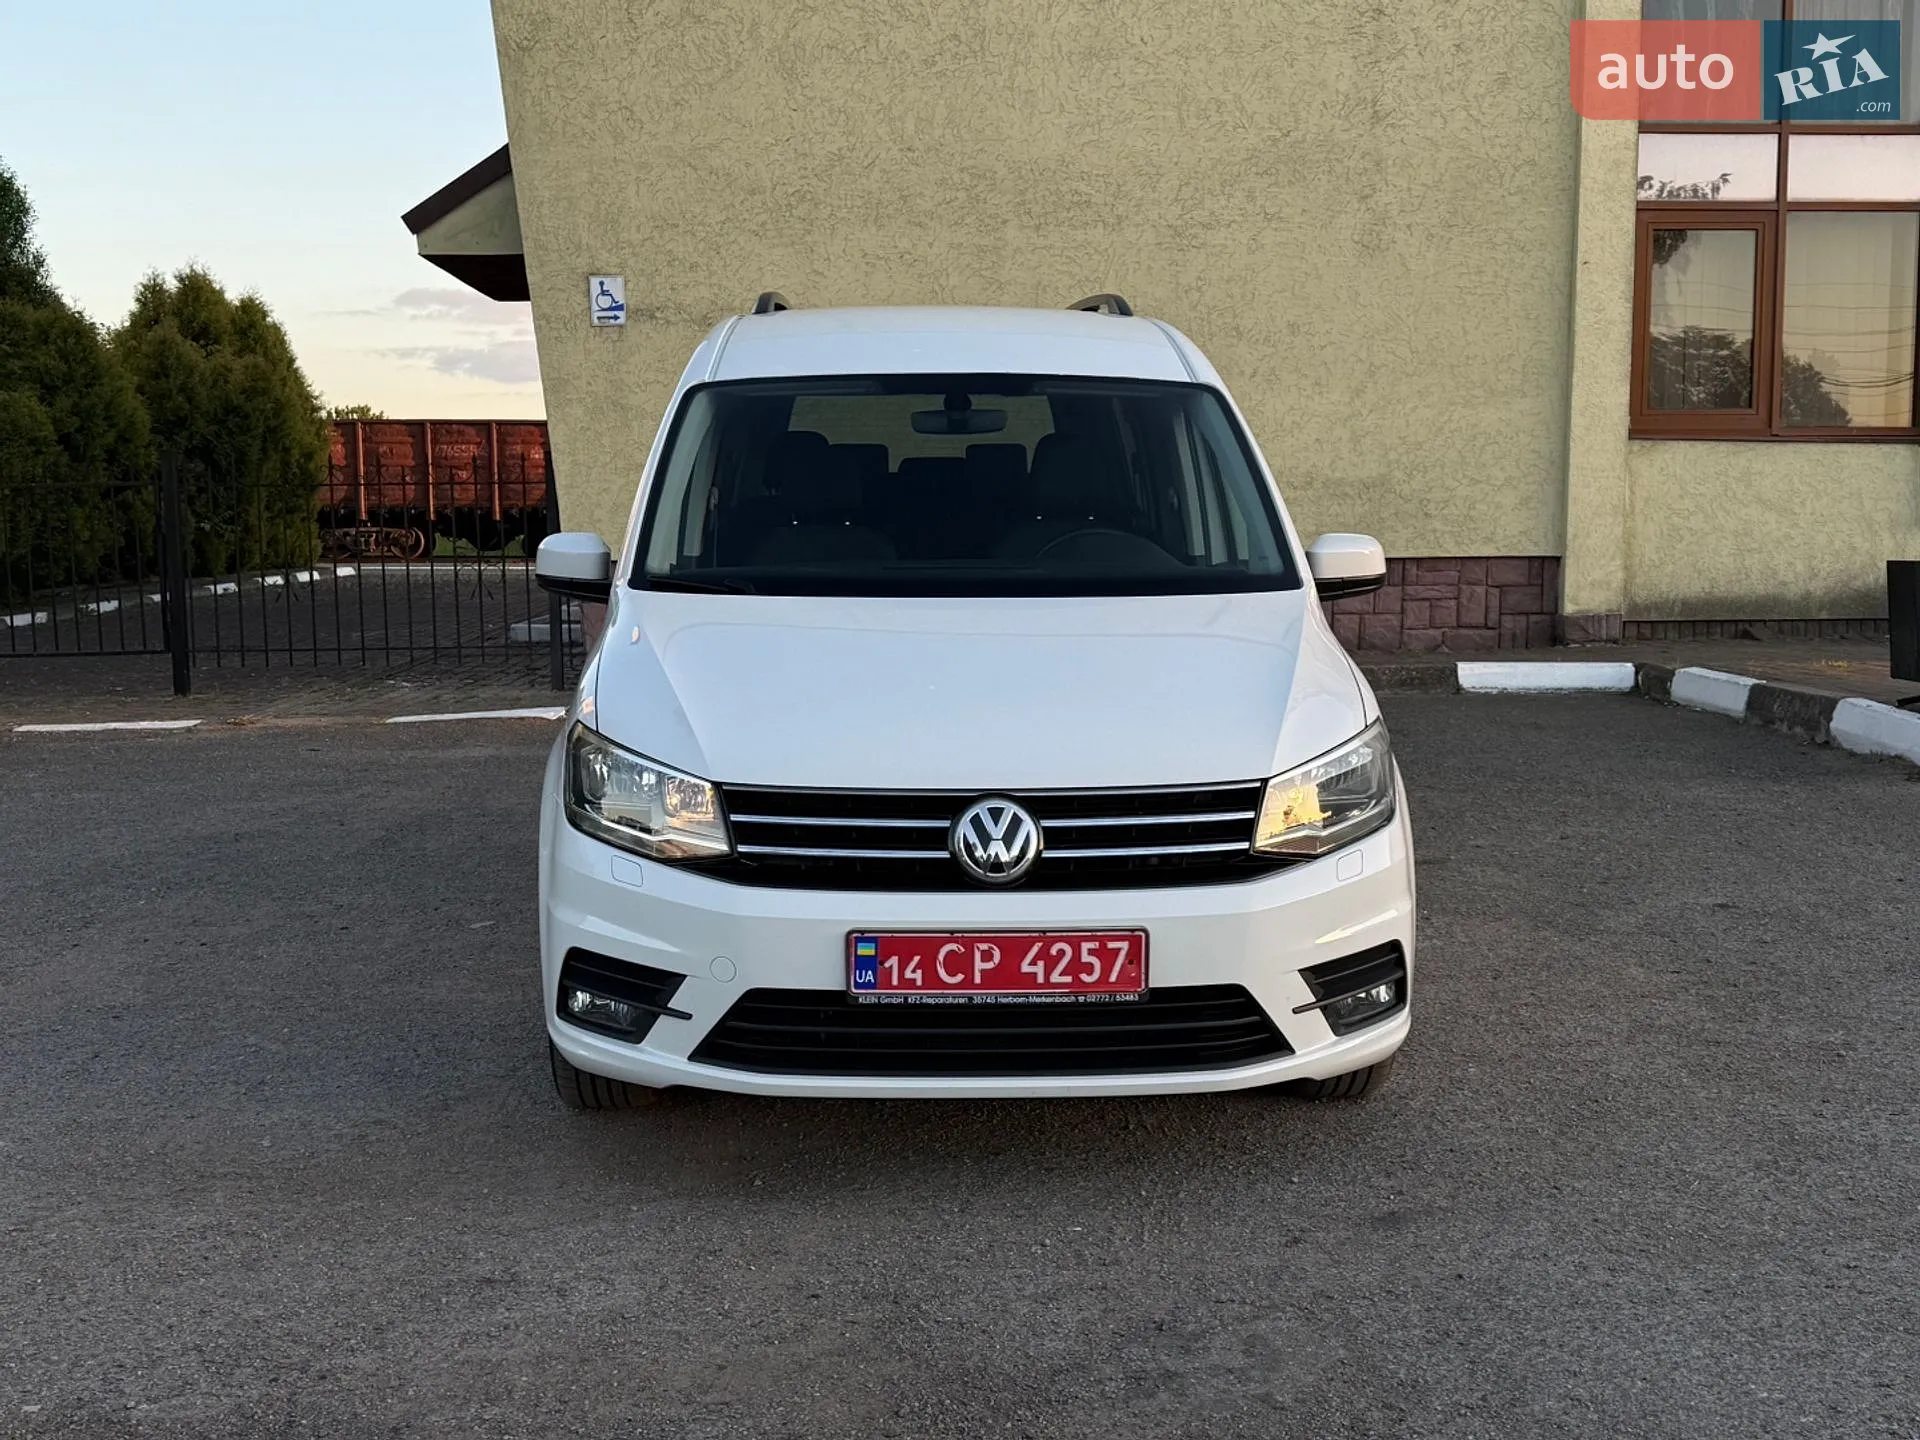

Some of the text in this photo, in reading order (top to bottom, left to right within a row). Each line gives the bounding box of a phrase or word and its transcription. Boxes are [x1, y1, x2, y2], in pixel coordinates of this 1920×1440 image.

[855, 969, 875, 984] UA
[882, 941, 1130, 986] 14 CP 4257
